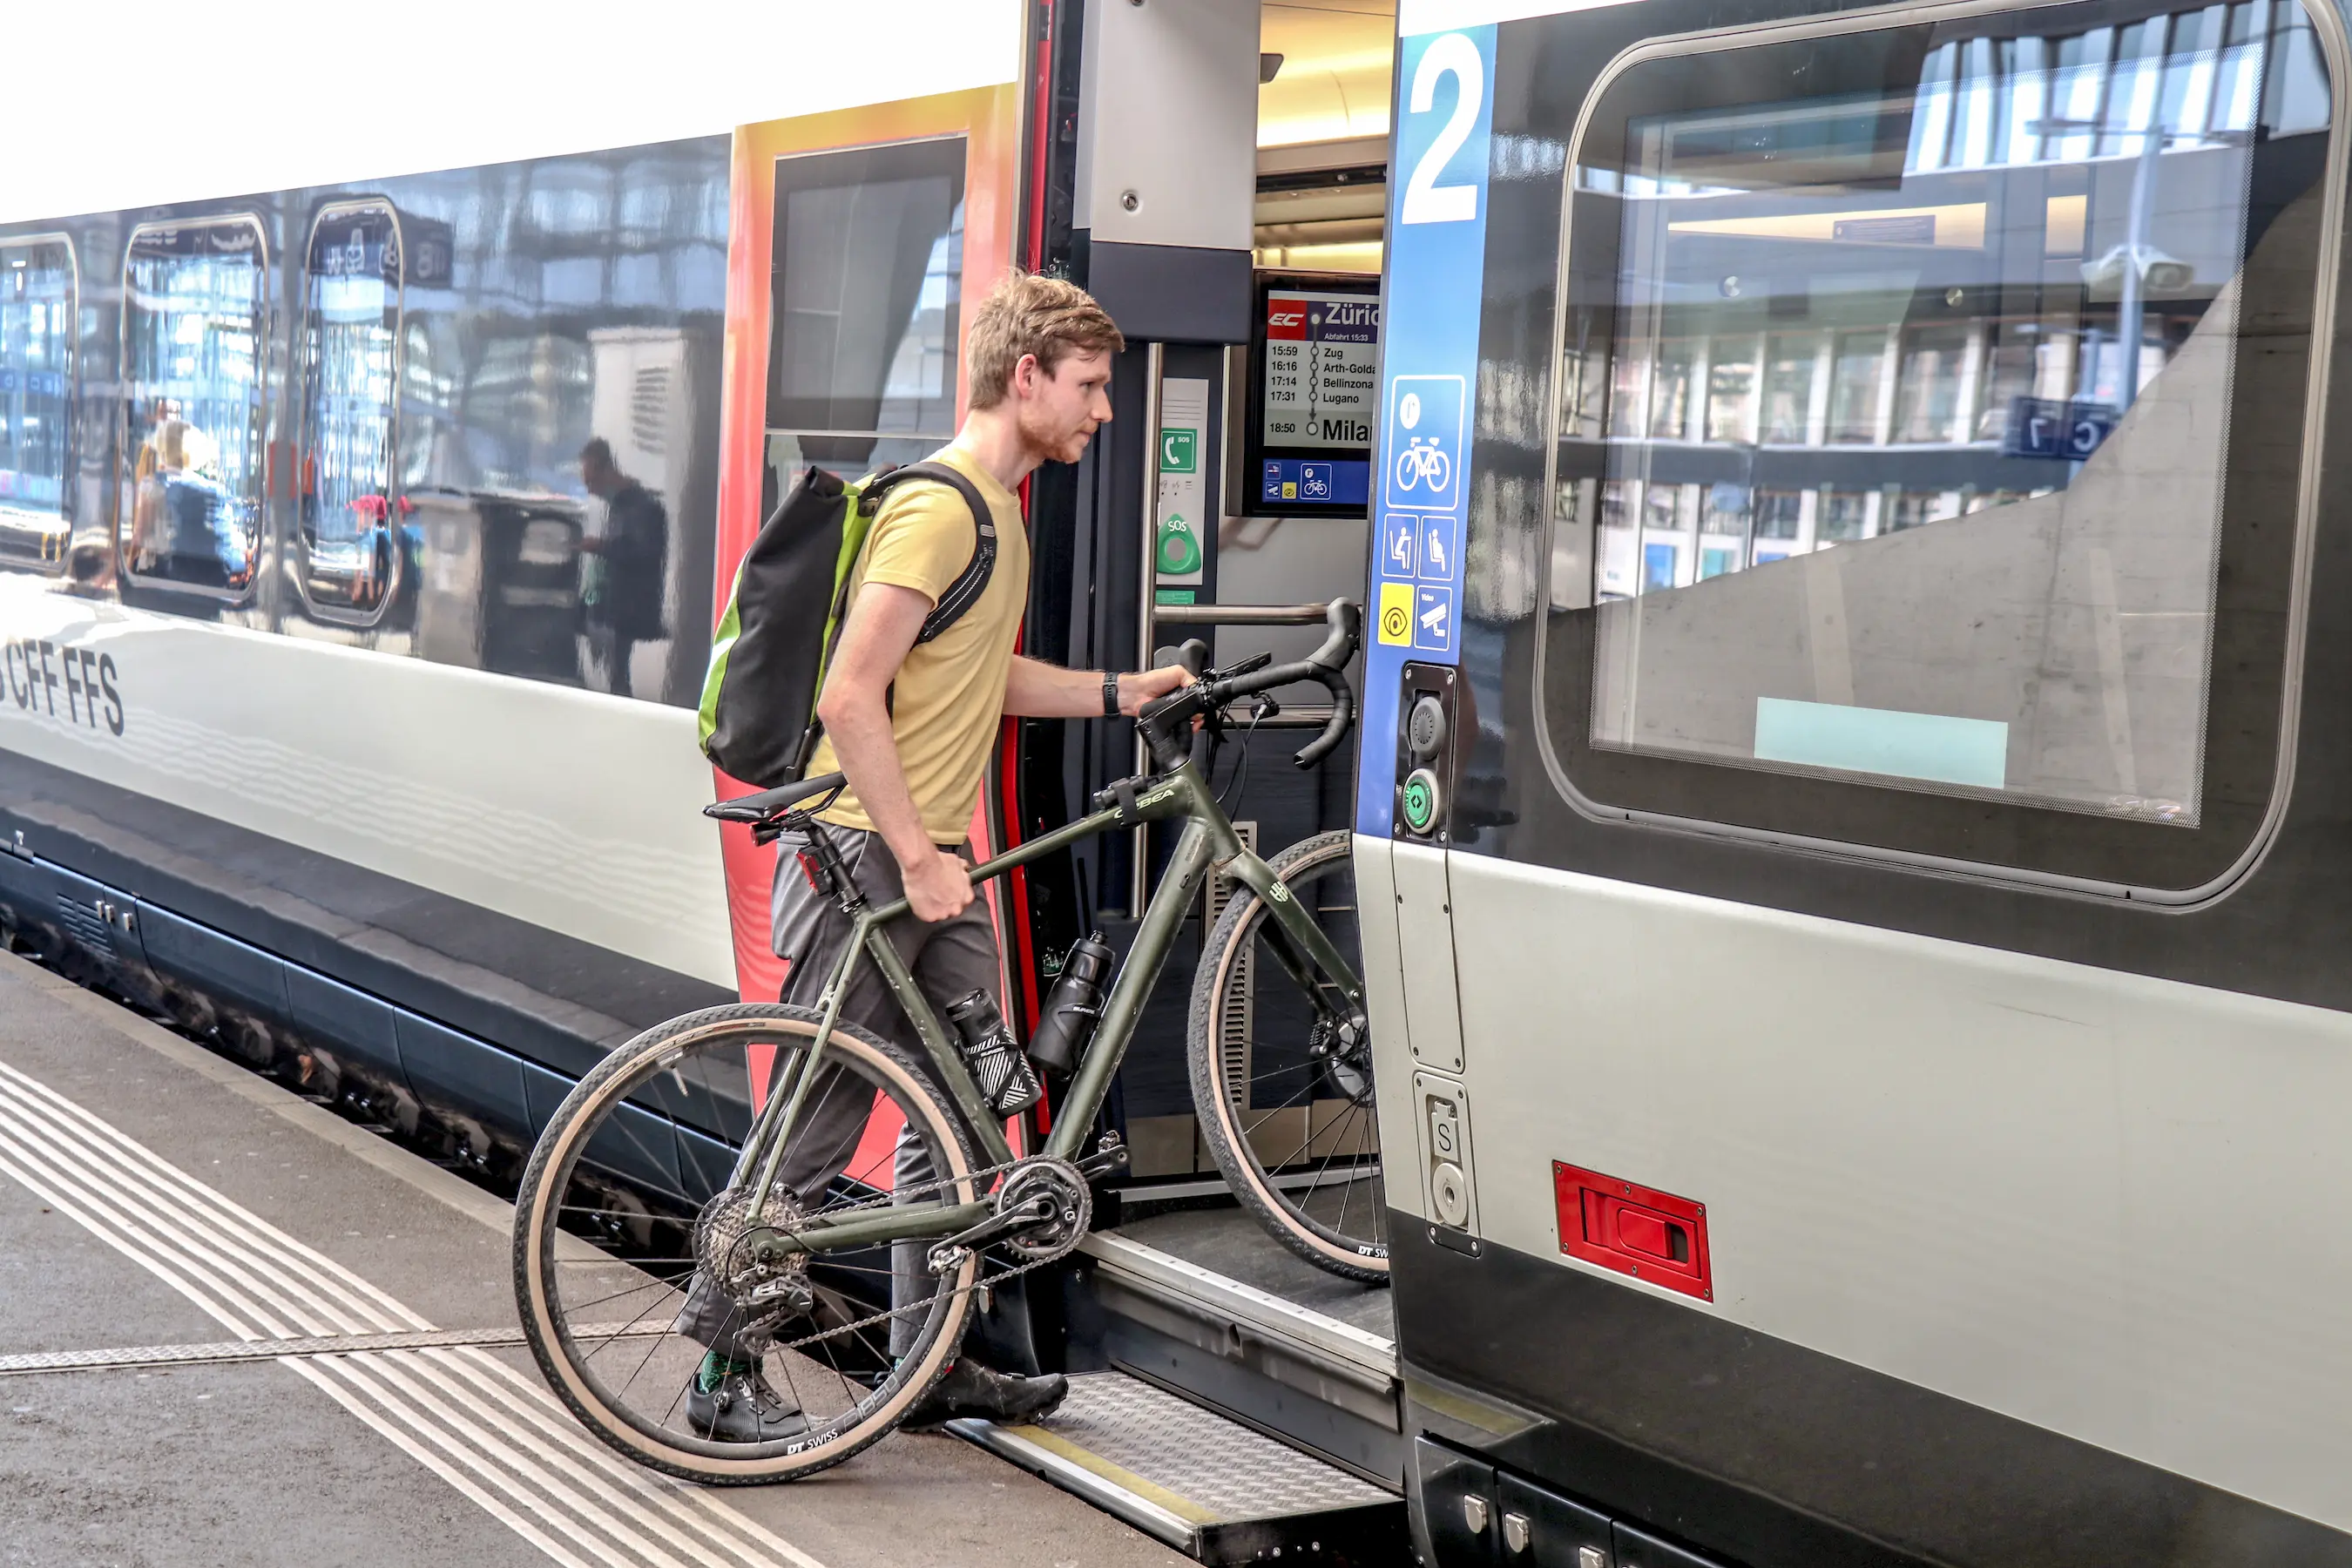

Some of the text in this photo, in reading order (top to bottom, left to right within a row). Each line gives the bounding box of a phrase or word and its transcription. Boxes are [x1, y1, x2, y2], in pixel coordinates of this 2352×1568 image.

[1402, 32, 1484, 225] 2
[1268, 313, 1304, 327] EC
[1272, 346, 1343, 359] 15:59 Zug
[1272, 362, 1297, 371] 16:16
[1271, 376, 1374, 389] 17:14 Bellinzona
[1271, 391, 1359, 404] 17:31 Lugano
[1270, 419, 1372, 442] 18:50 Mila
[1167, 520, 1186, 532] SOS
[6, 636, 58, 716] CFF
[62, 645, 124, 737] FFS
[1438, 1123, 1452, 1152] S
[1358, 1245, 1373, 1255] DT
[787, 1442, 804, 1455] DT
[807, 1428, 838, 1450] SWISS
